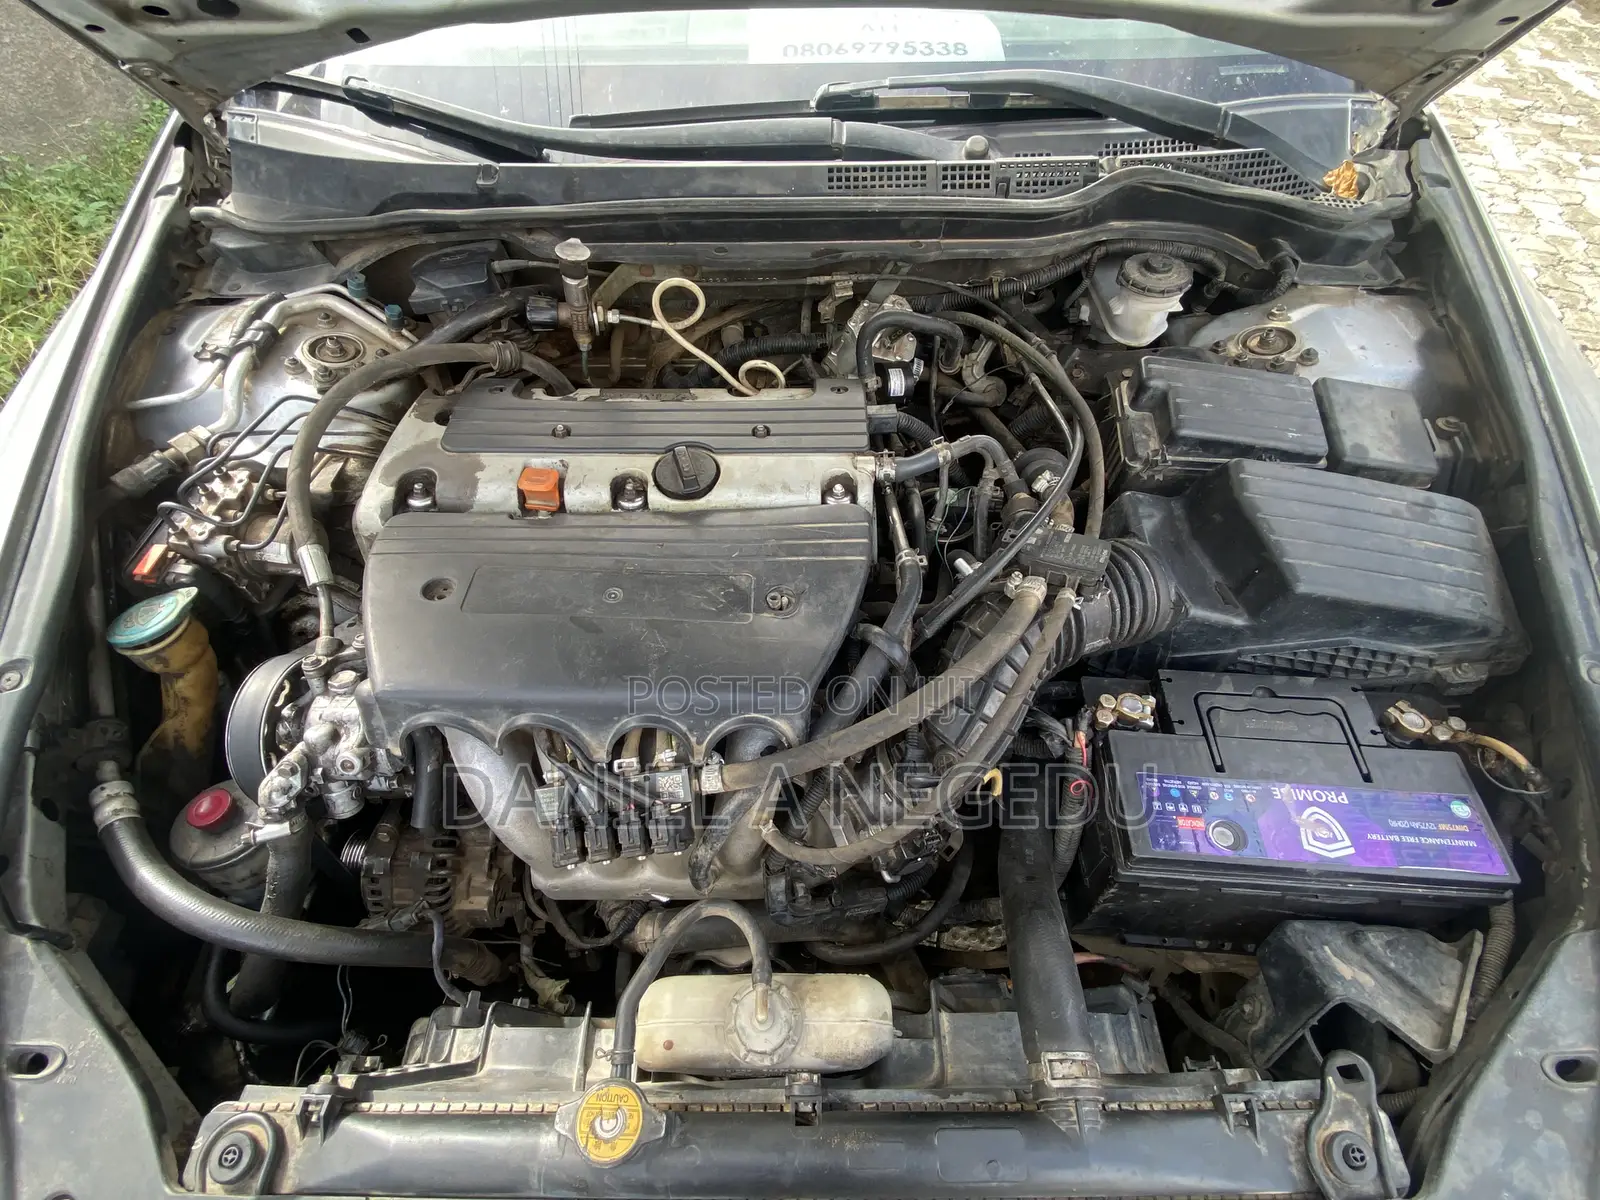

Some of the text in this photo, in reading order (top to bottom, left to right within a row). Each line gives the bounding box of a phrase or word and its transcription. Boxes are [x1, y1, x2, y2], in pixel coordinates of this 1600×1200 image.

[782, 41, 969, 57] 08069795338
[1367, 833, 1477, 847] MAINTENANCE FREE BATTERY
[596, 1092, 629, 1103] CAUTION
